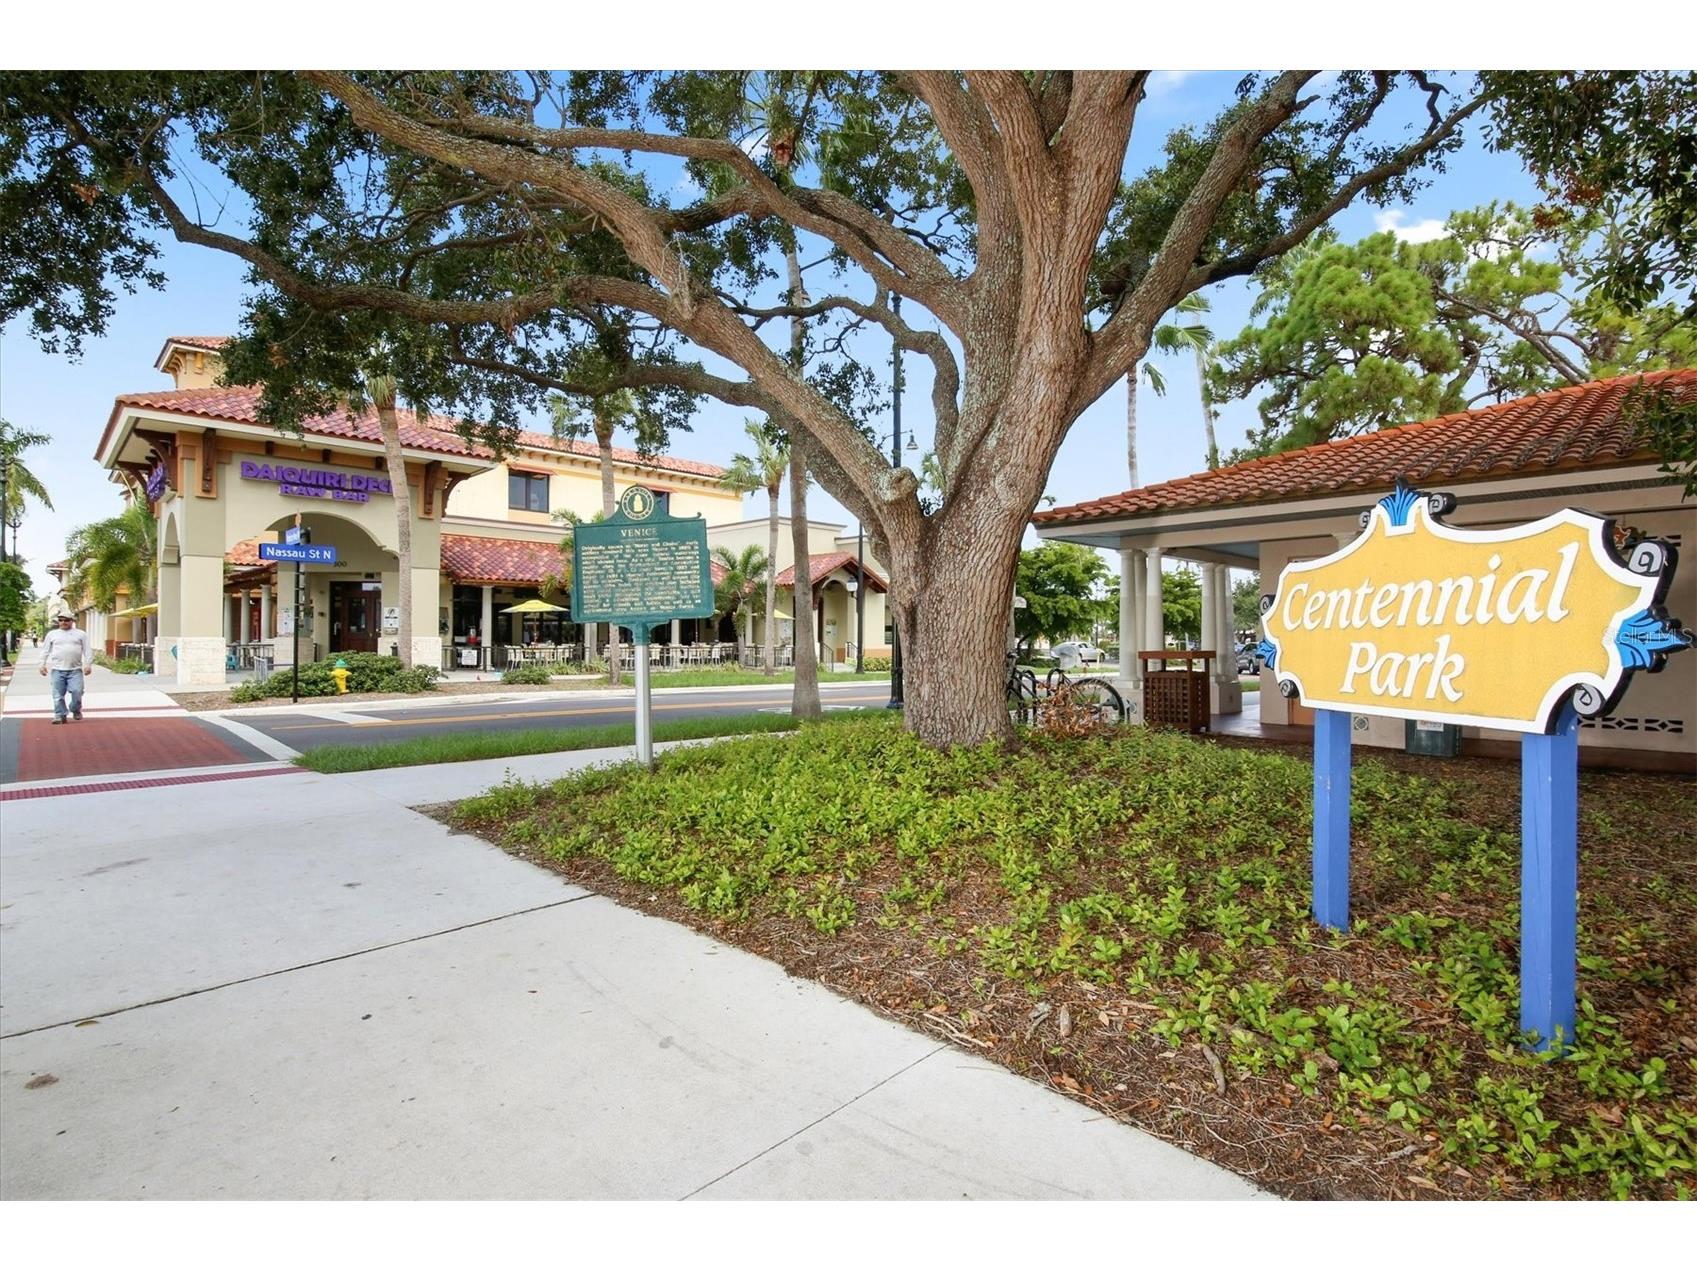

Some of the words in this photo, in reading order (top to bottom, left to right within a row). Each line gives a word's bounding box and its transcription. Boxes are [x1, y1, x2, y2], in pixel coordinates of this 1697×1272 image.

[240, 461, 347, 488] DAIQUIRI
[280, 484, 326, 498] RAW
[332, 489, 370, 503] BAR
[620, 528, 657, 537] VENICE
[266, 546, 305, 558] Nassau
[308, 549, 320, 559] St
[323, 550, 331, 560] N
[1282, 541, 1580, 631] Centennial
[1339, 633, 1466, 703] Park
